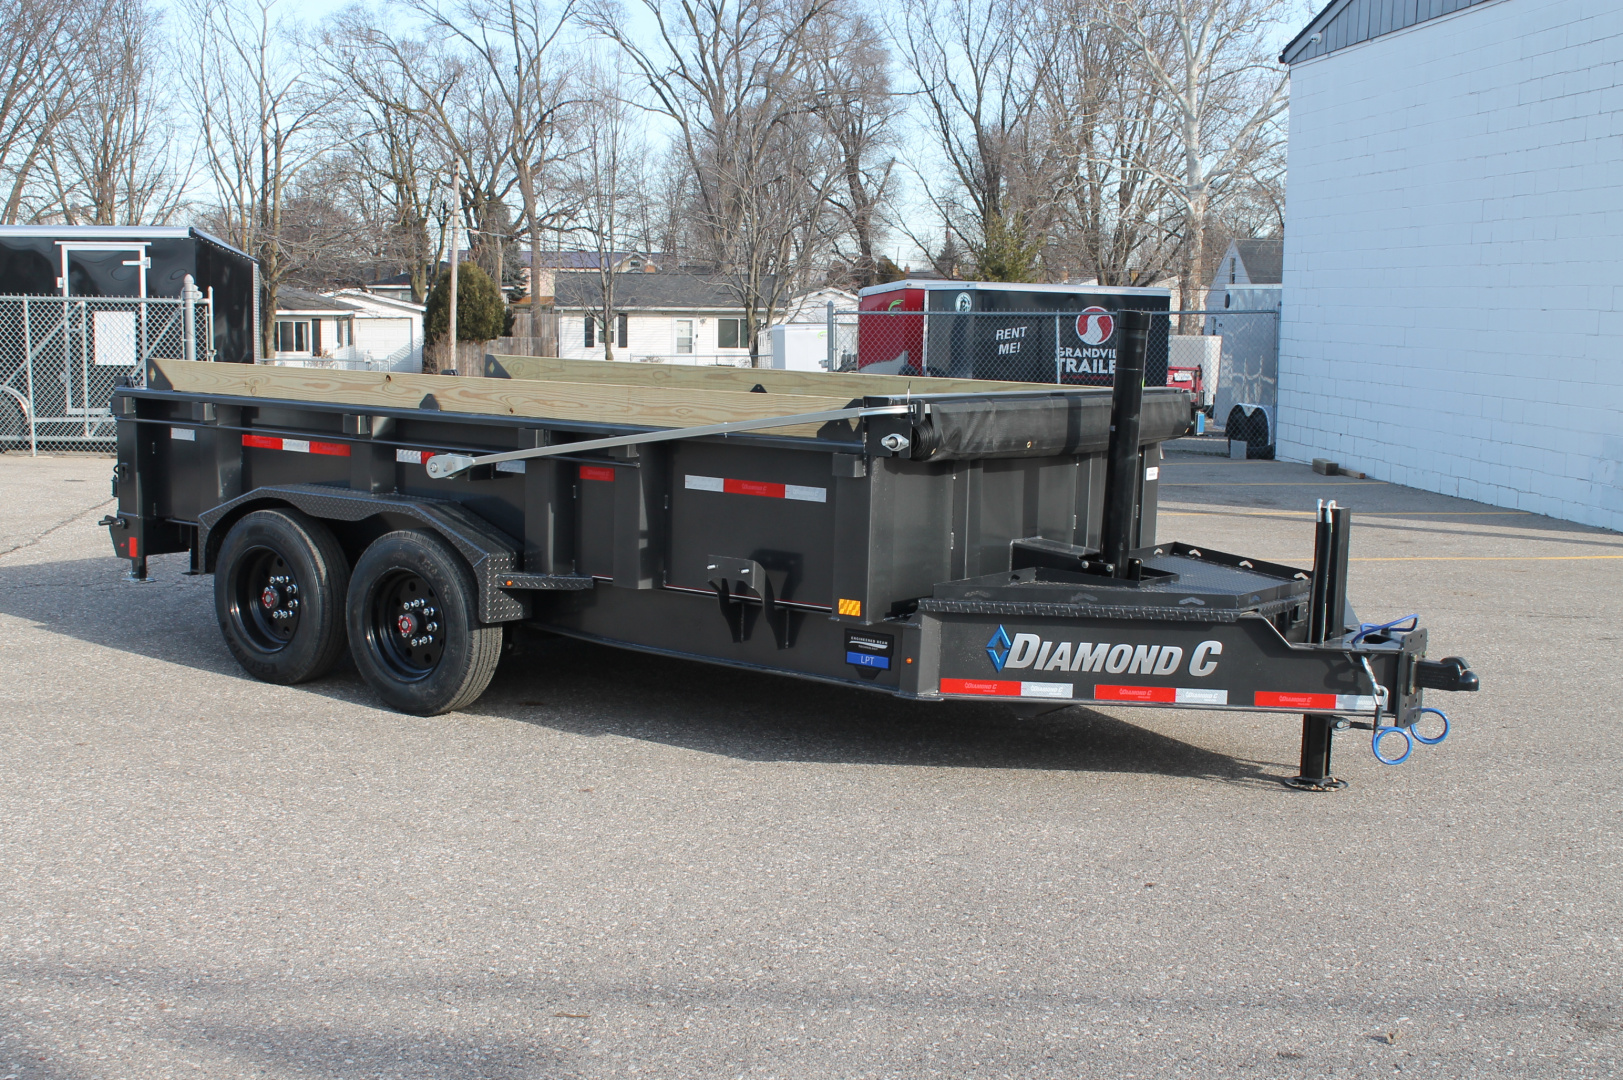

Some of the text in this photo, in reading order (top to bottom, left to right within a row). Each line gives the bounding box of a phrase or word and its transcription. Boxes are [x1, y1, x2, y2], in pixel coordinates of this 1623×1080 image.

[995, 326, 1028, 341] RENT
[998, 342, 1021, 355] ME!
[860, 655, 875, 666] LPT
[1003, 632, 1223, 677] DIAMOND C
